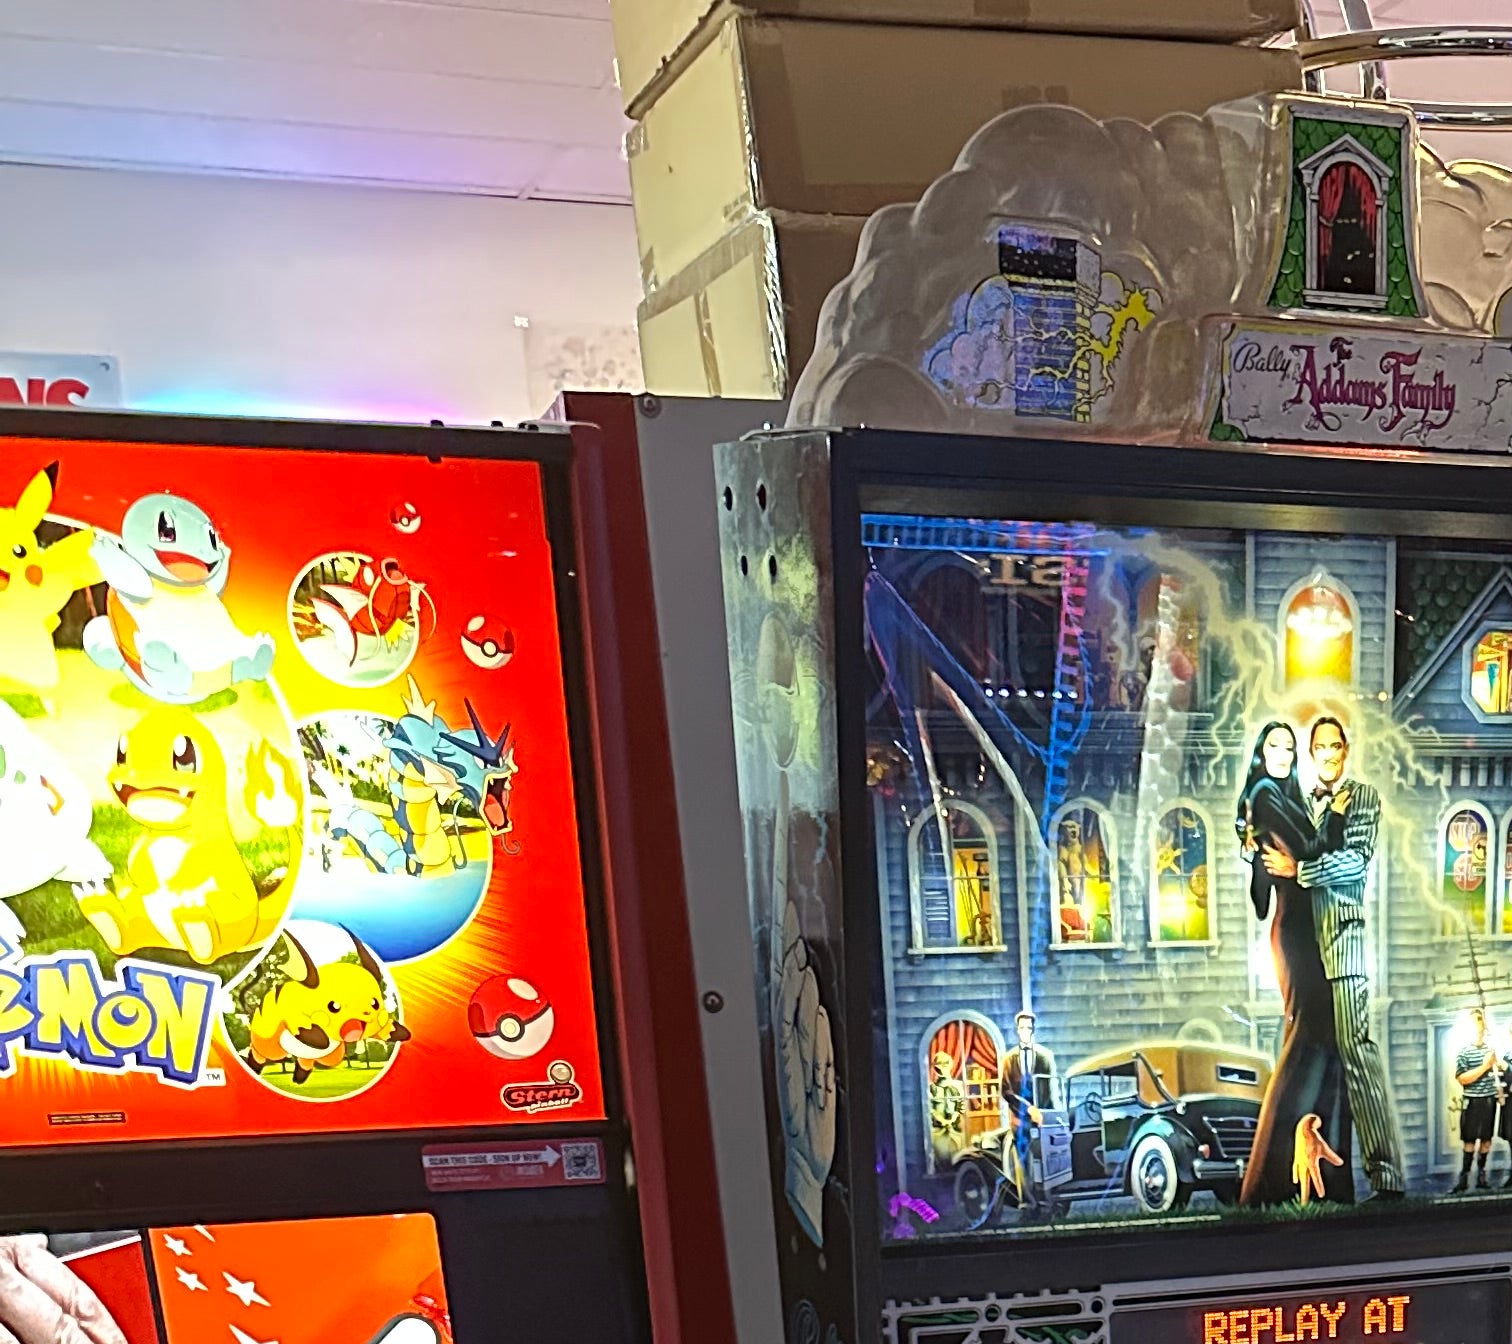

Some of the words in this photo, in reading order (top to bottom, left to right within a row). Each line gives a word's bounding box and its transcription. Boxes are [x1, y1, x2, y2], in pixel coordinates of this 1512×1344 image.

[1232, 343, 1291, 377] Bally
[1284, 344, 1388, 430] Addams
[1379, 347, 1456, 432] Family
[511, 1088, 572, 1104] Stern
[1363, 1295, 1411, 1334] AT
